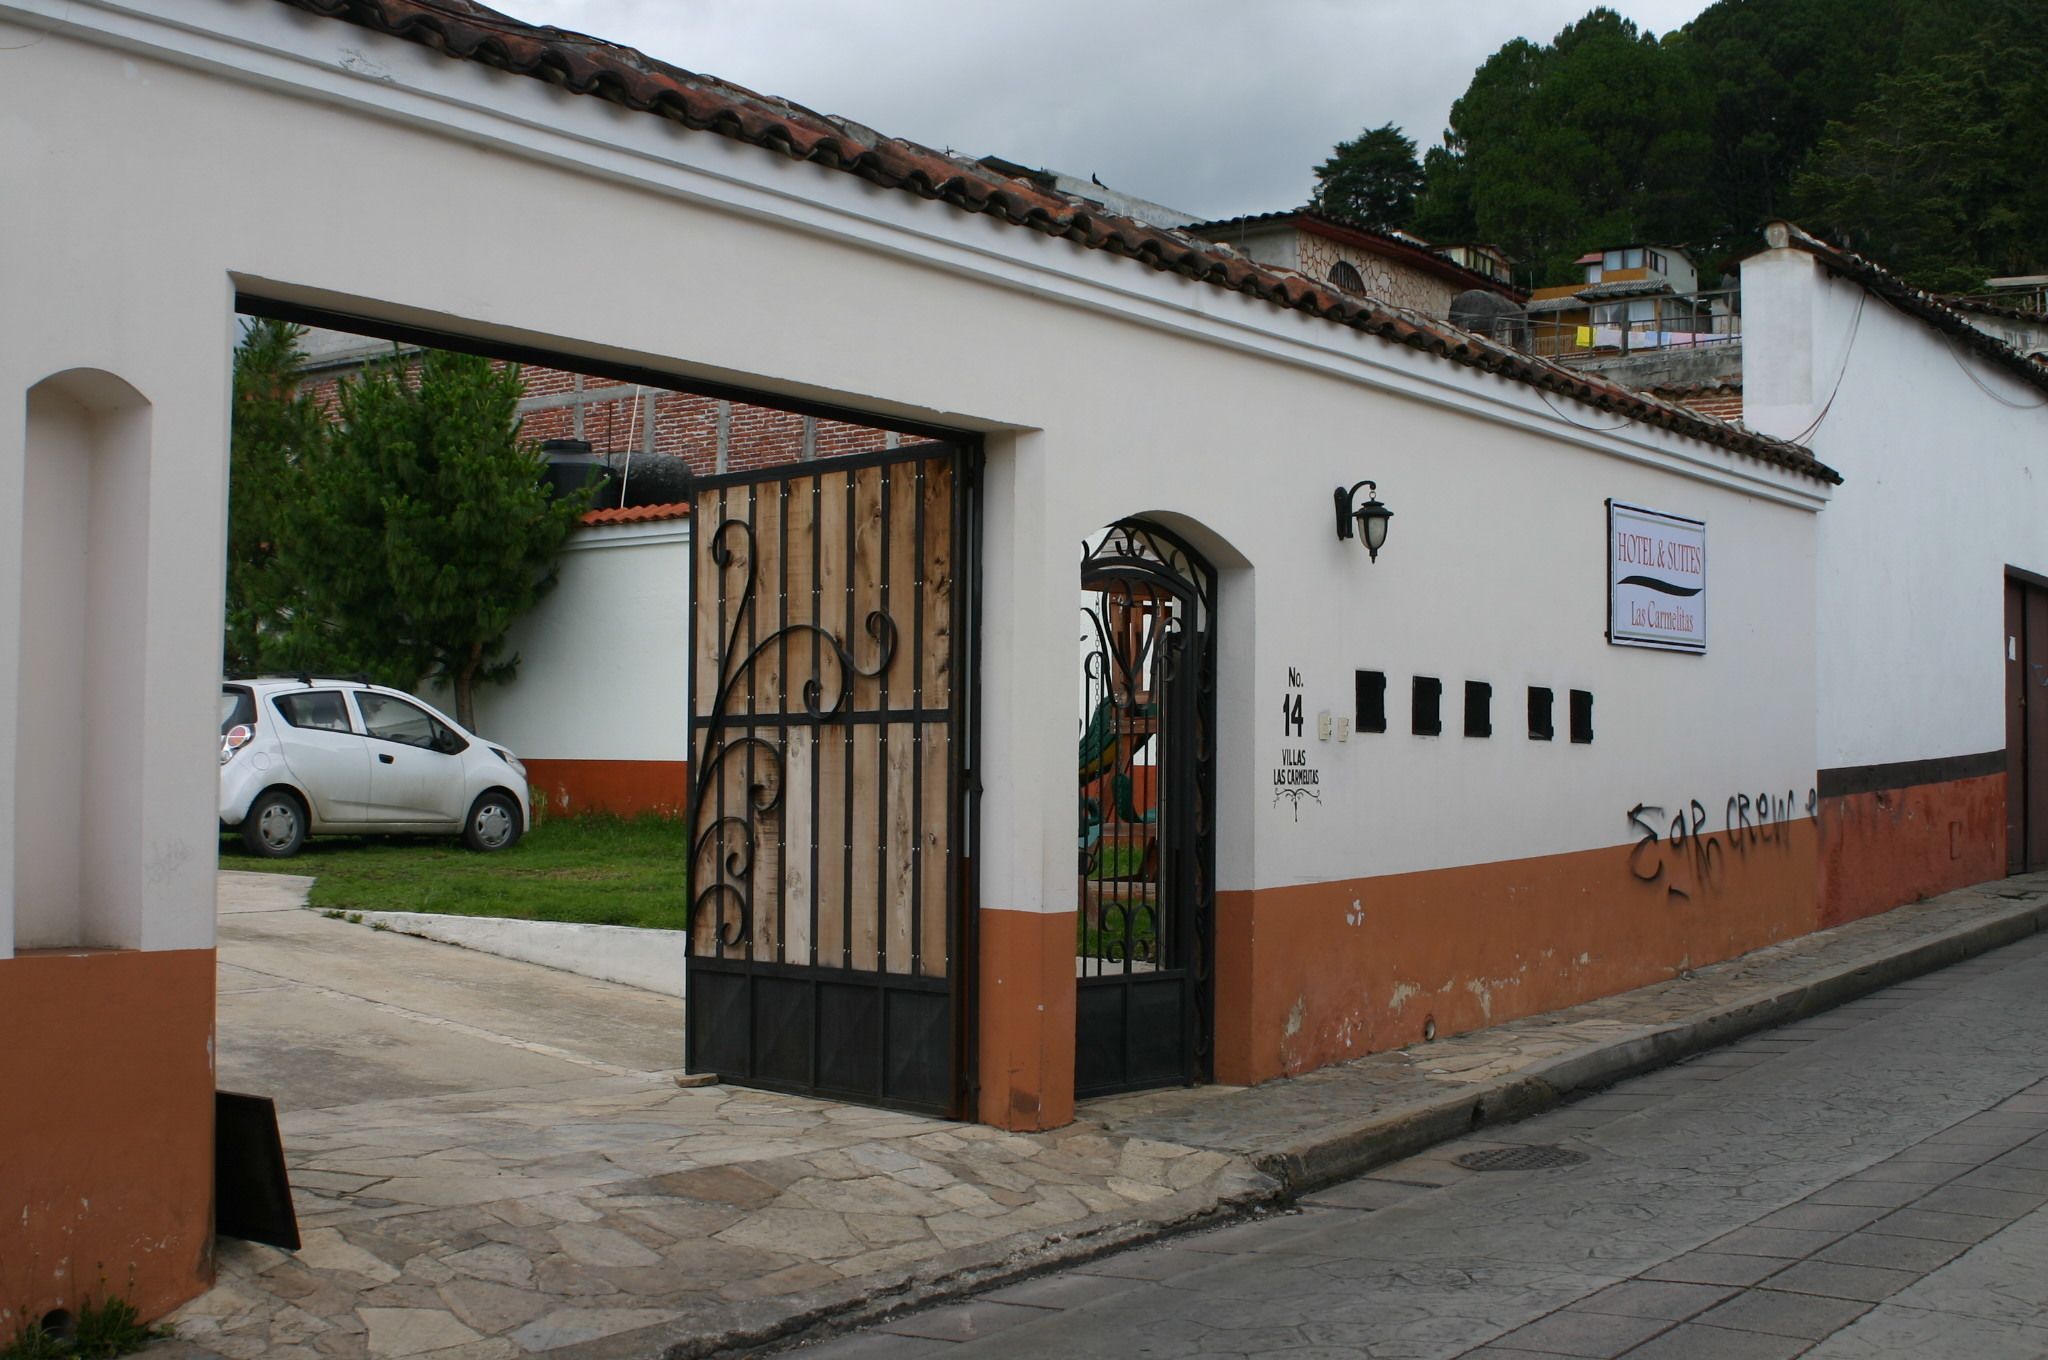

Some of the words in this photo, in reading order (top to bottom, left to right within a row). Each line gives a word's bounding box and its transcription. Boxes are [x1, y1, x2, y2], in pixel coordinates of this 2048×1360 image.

[1617, 532, 1655, 566] HOTEL
[1657, 539, 1665, 568] &
[1667, 541, 1702, 574] SUITES
[1631, 600, 1646, 626] Las
[1647, 600, 1694, 632] Carmelitas
[1288, 666, 1304, 688] No.
[1282, 693, 1304, 737] 14
[1282, 748, 1306, 766] VILLAS
[1273, 768, 1286, 785] LAS
[1287, 768, 1320, 785] CARMELITAS
